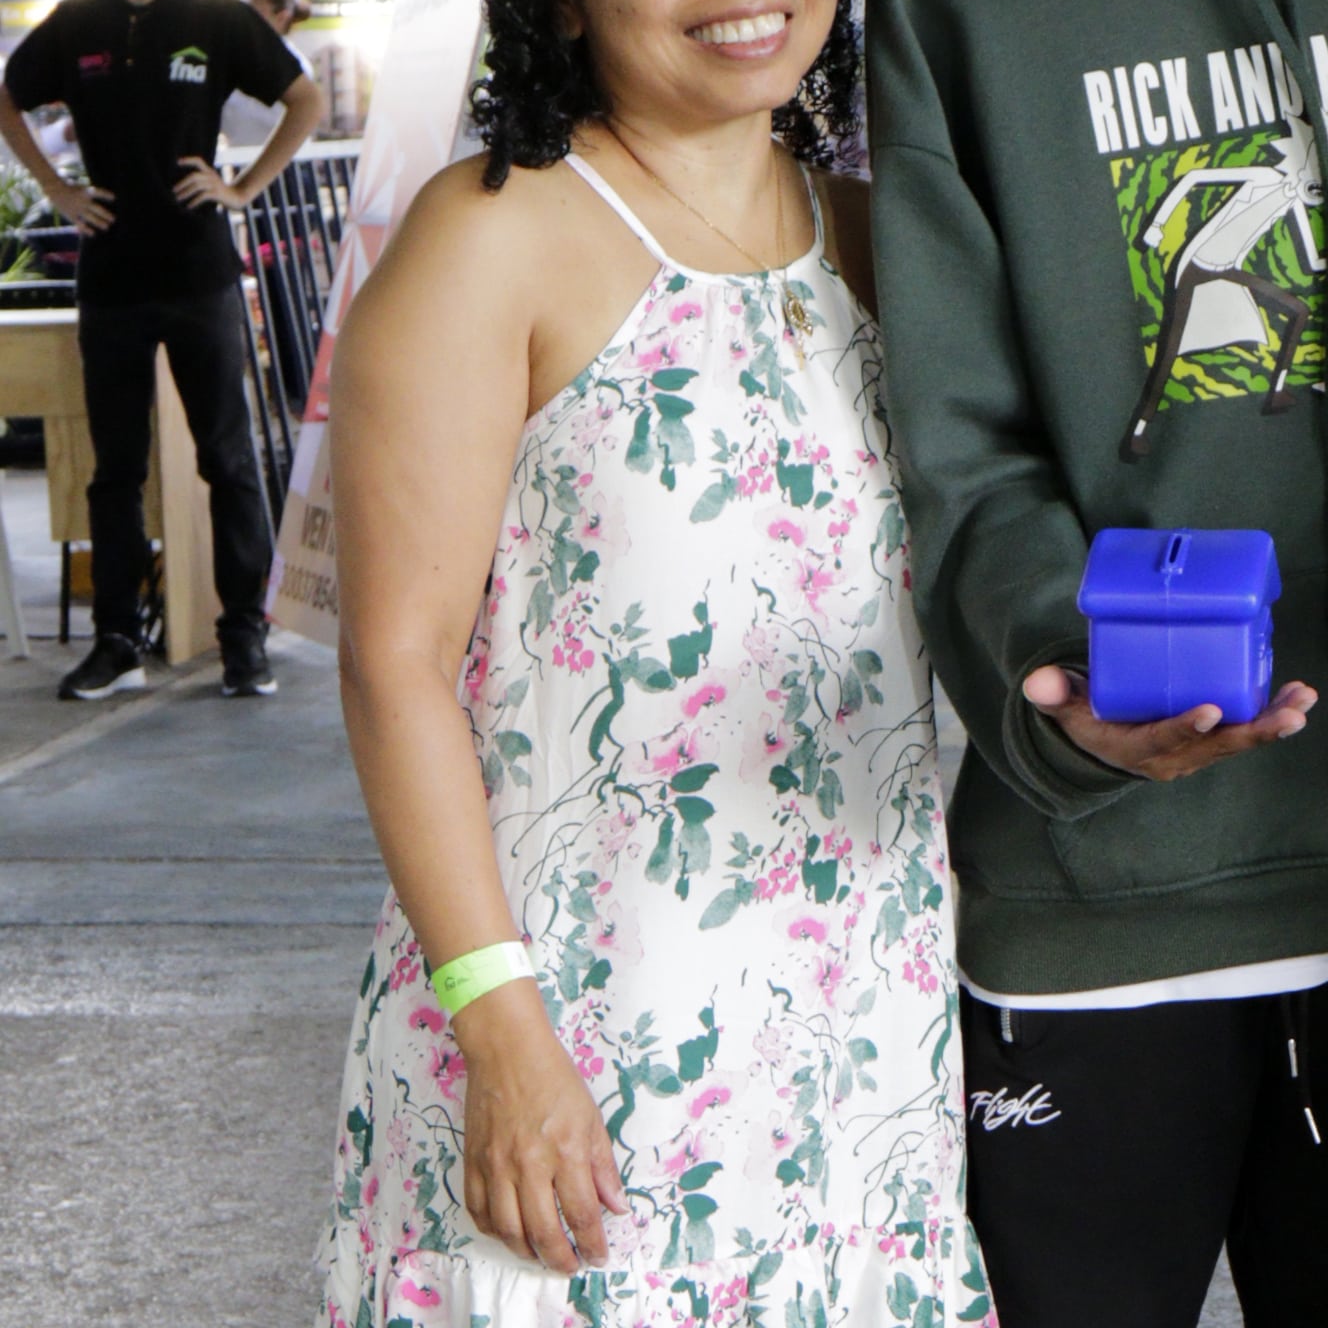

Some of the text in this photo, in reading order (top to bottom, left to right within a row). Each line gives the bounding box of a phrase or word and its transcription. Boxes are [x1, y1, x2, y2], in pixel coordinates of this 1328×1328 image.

[169, 56, 207, 83] fna
[1083, 57, 1201, 155] RICK
[1207, 41, 1305, 134] AND
[969, 1083, 1062, 1132] Flight
